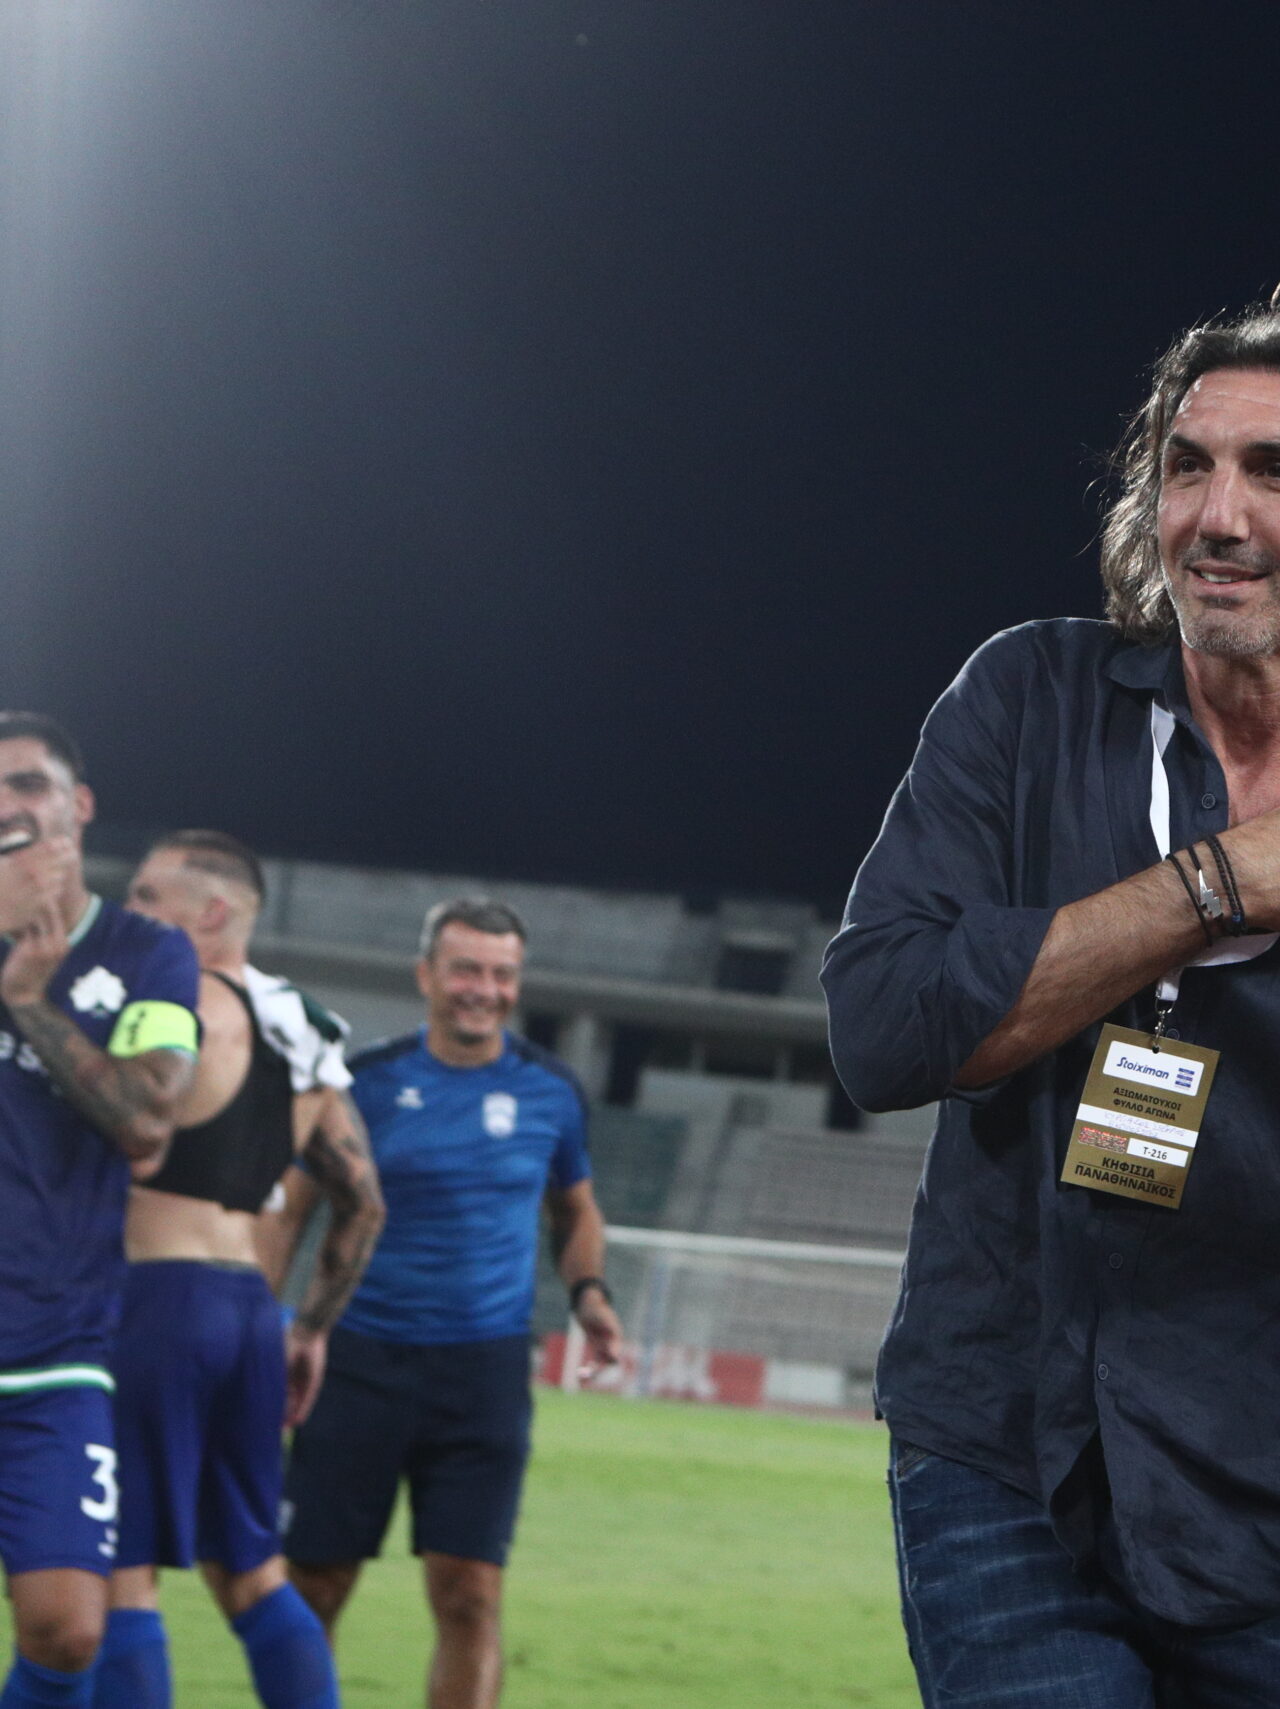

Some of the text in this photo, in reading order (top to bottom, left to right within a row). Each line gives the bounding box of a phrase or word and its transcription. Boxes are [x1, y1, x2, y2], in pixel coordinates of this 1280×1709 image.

[1116, 1056, 1170, 1079] Stoiximan
[1113, 1087, 1182, 1111] ΑΞΙΩΜΑΤΟΥΧΟΙ
[1113, 1098, 1176, 1121] ΦΥΛΛΟ ΑΓΩΝΑ
[1143, 1146, 1168, 1160] T-216
[1102, 1157, 1155, 1180] ΚΗΦΙΣΙΑ
[80, 1443, 119, 1521] 3
